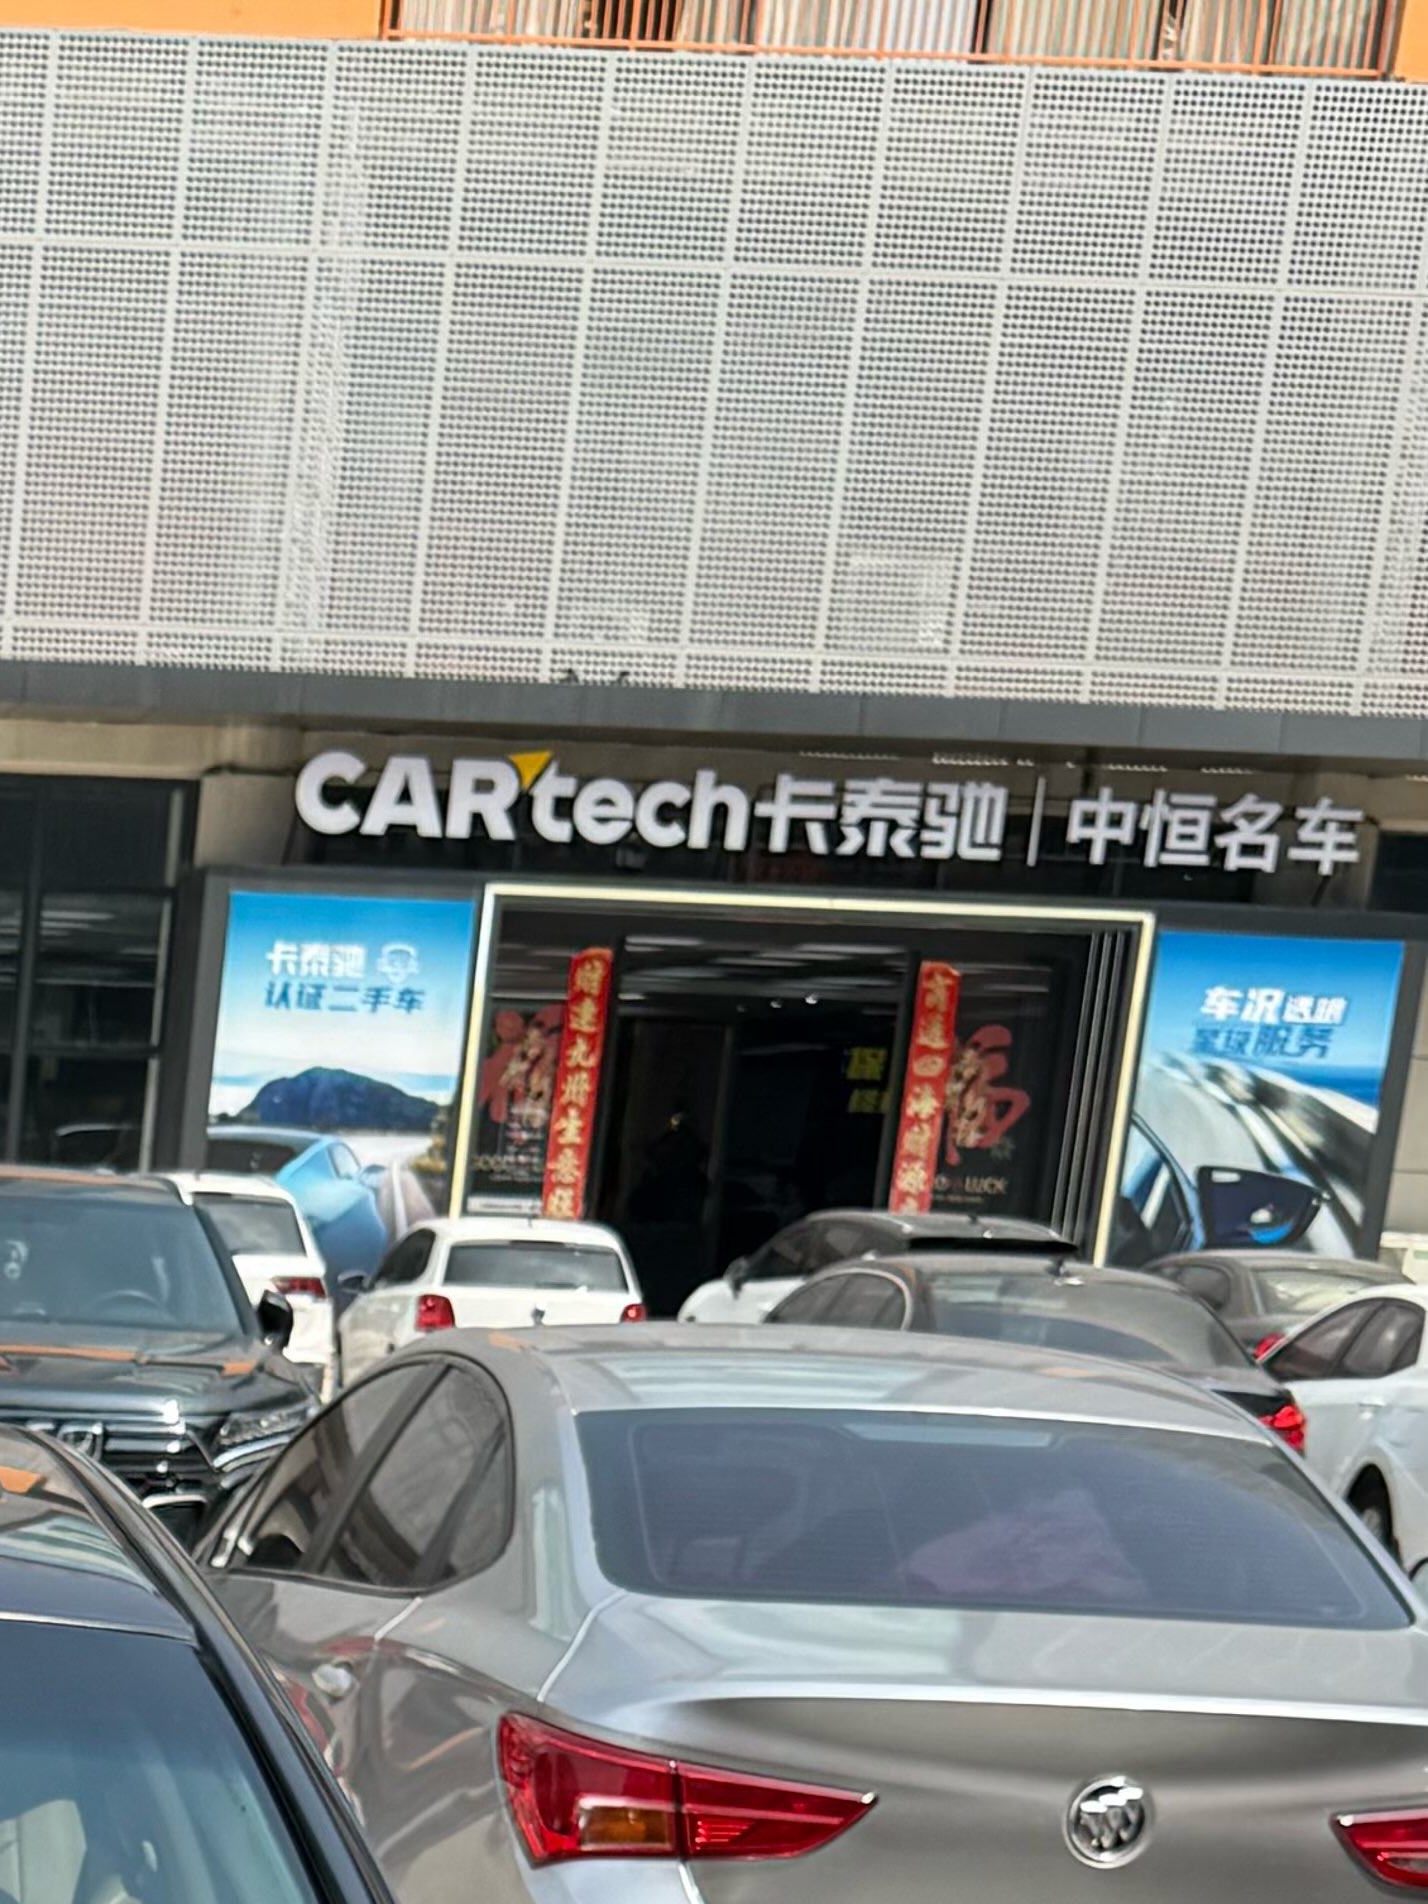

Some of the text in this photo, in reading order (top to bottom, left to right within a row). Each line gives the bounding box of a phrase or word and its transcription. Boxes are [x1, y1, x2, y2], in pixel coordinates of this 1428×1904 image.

[1065, 786, 1365, 876] 中恒名车
[265, 941, 366, 978] 卡泰驰
[265, 981, 425, 1014] 认证二手车
[1200, 985, 1347, 1024] 车况透明
